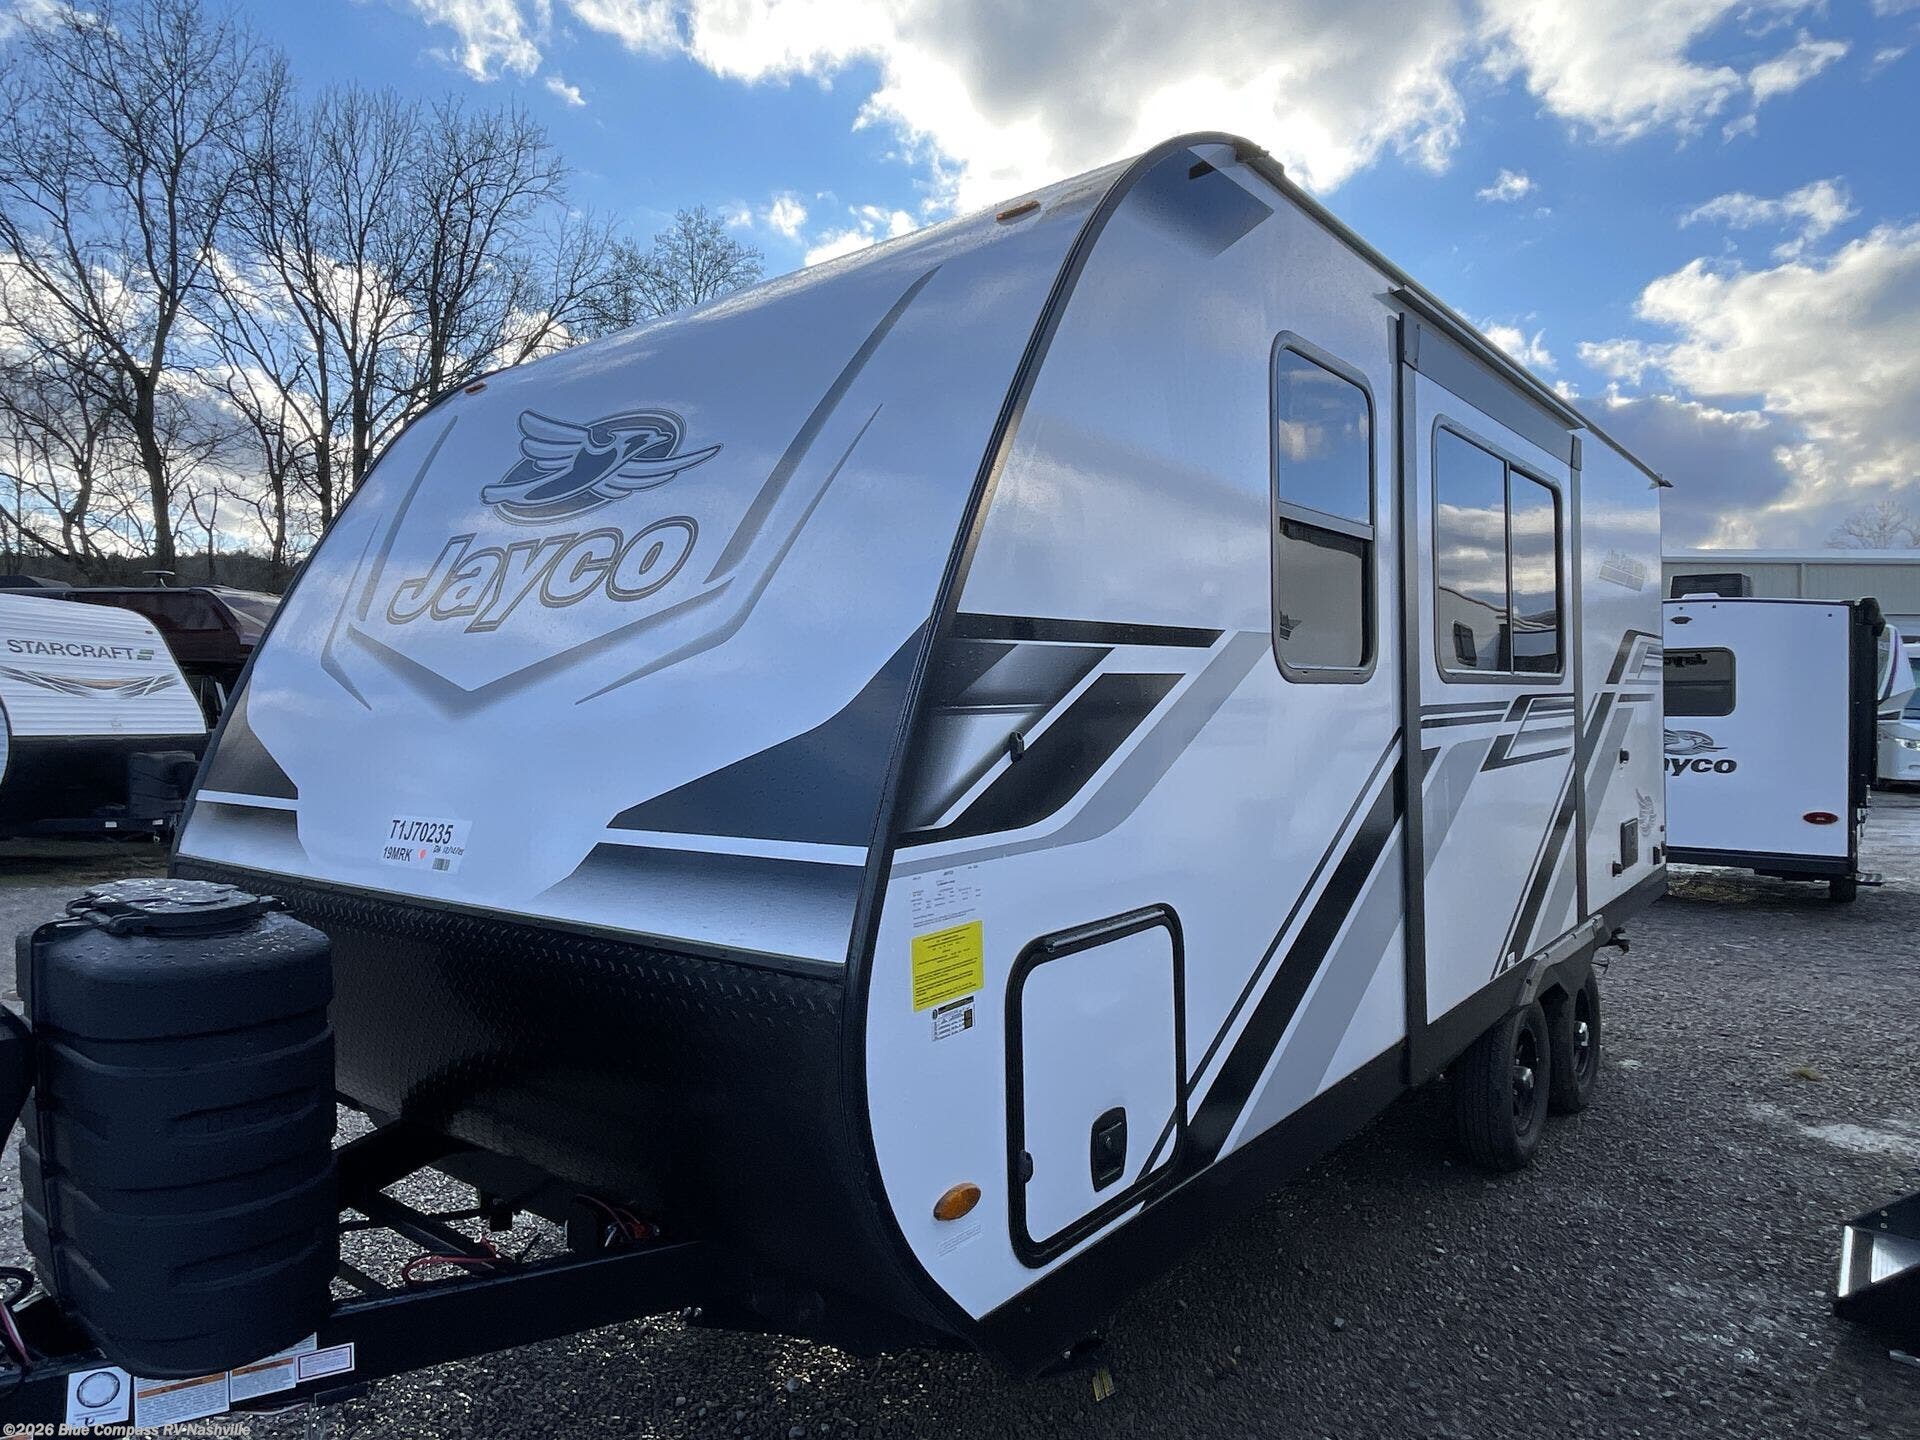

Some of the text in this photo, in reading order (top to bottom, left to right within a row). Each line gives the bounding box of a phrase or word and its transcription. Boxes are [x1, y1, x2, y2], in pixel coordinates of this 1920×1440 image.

[386, 515, 699, 633] Jayco
[7, 639, 133, 660] STARCRAFT
[390, 819, 454, 844] T1J70235
[383, 846, 413, 862] 19MRK
